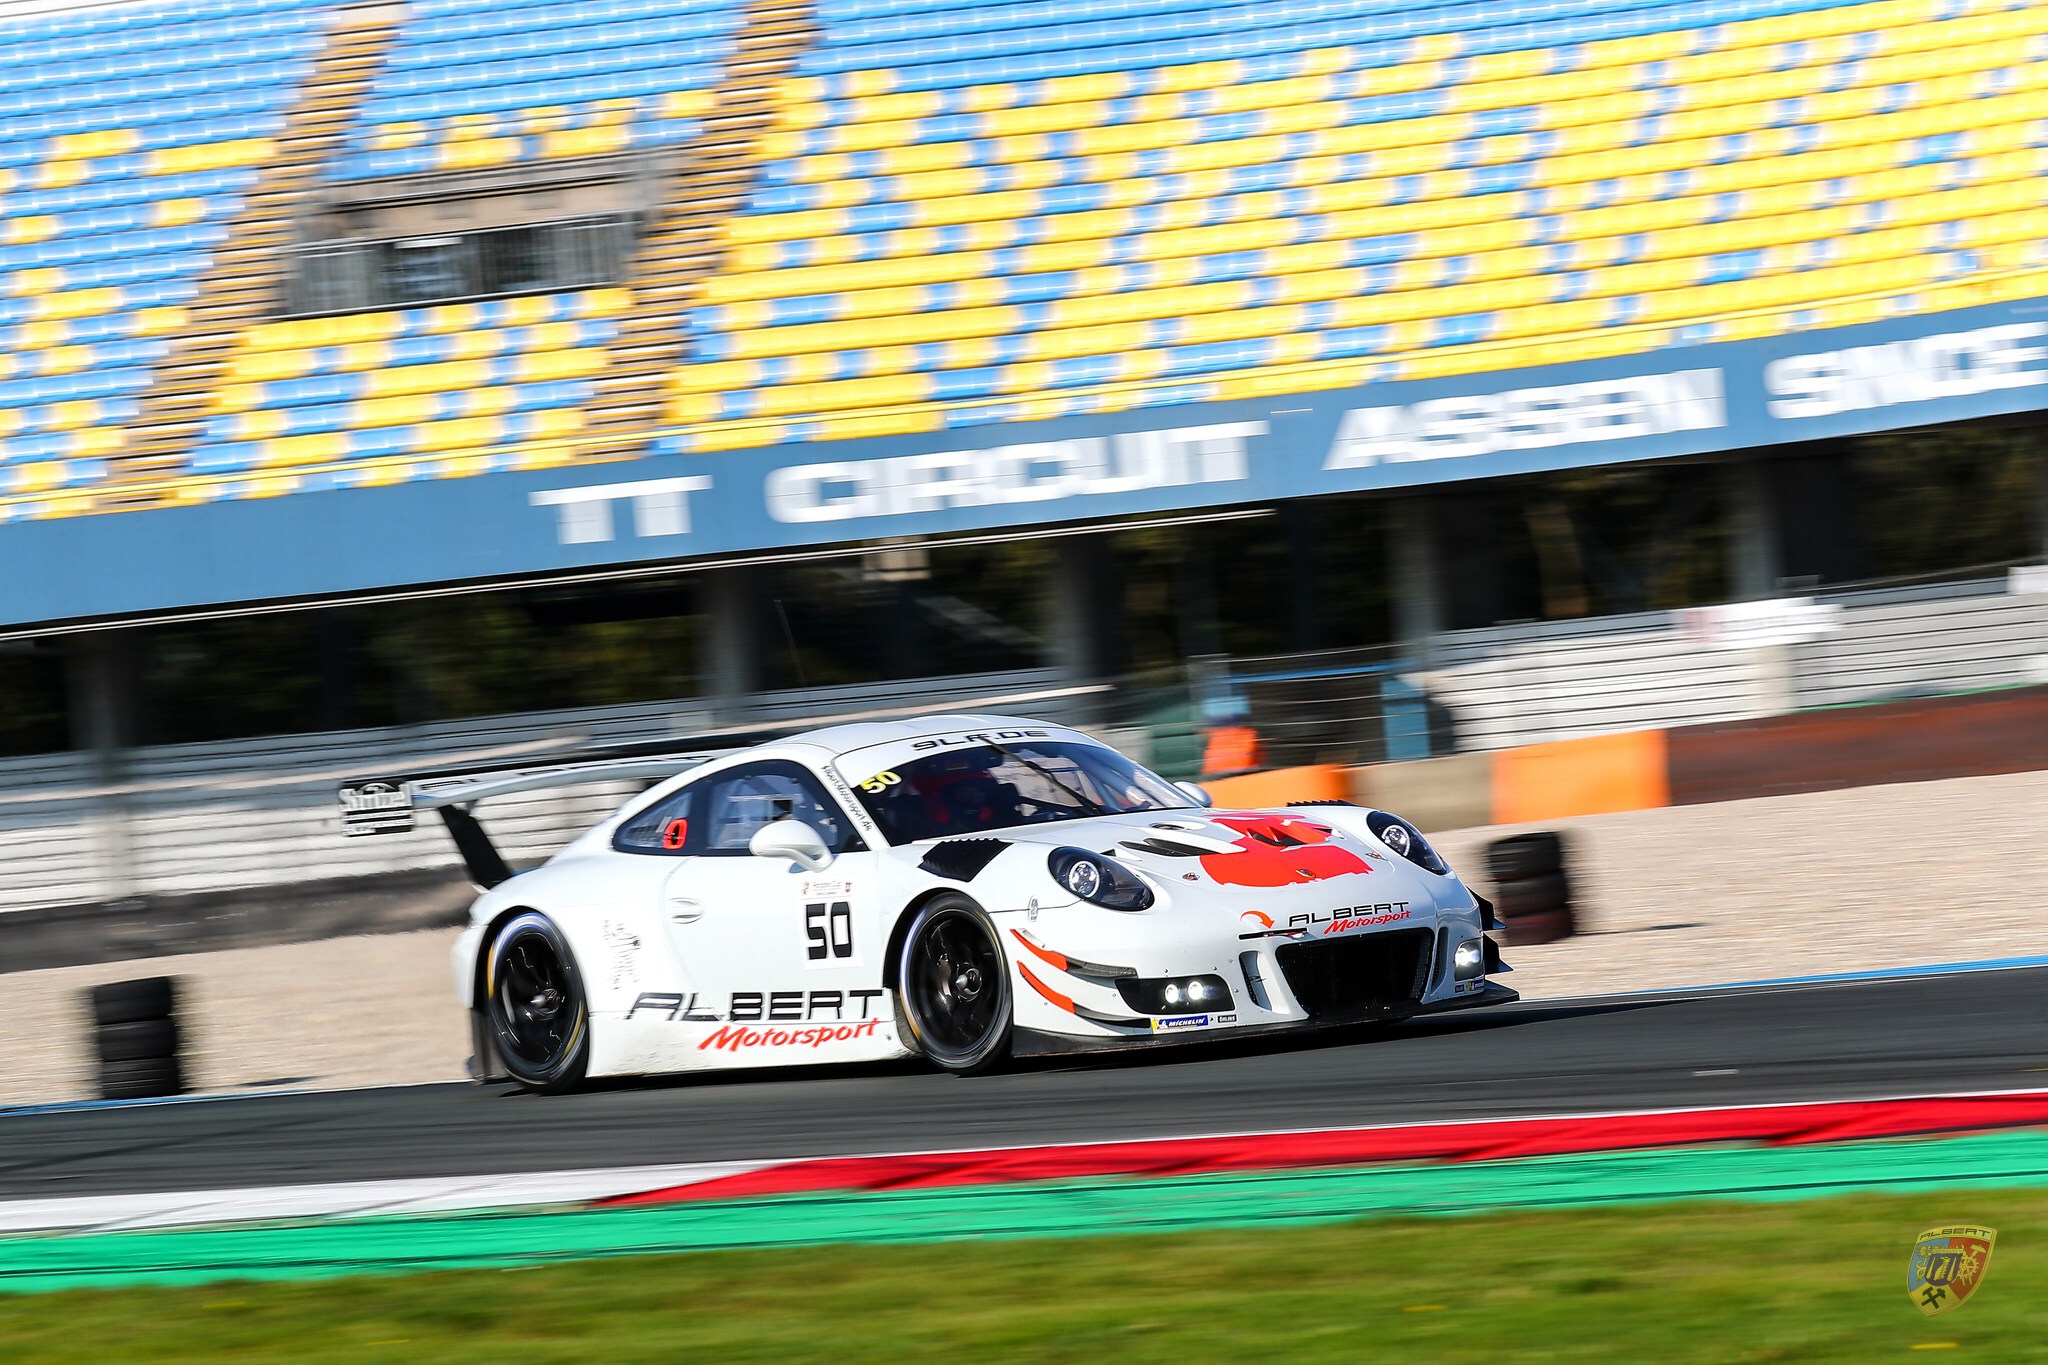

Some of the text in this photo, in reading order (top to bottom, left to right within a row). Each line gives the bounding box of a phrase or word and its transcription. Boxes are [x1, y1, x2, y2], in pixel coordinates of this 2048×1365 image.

[528, 475, 713, 545] TT
[764, 420, 1270, 524] CIRCUIT
[1321, 366, 1728, 471] ASSEN
[859, 770, 903, 795] 50
[1288, 901, 1410, 928] ALBERT
[1323, 909, 1412, 935] Motorsport
[805, 901, 852, 960] 50
[623, 989, 884, 1022] ALBERT
[696, 1017, 882, 1052] Motorsport
[1168, 1017, 1206, 1028] MICHELIN
